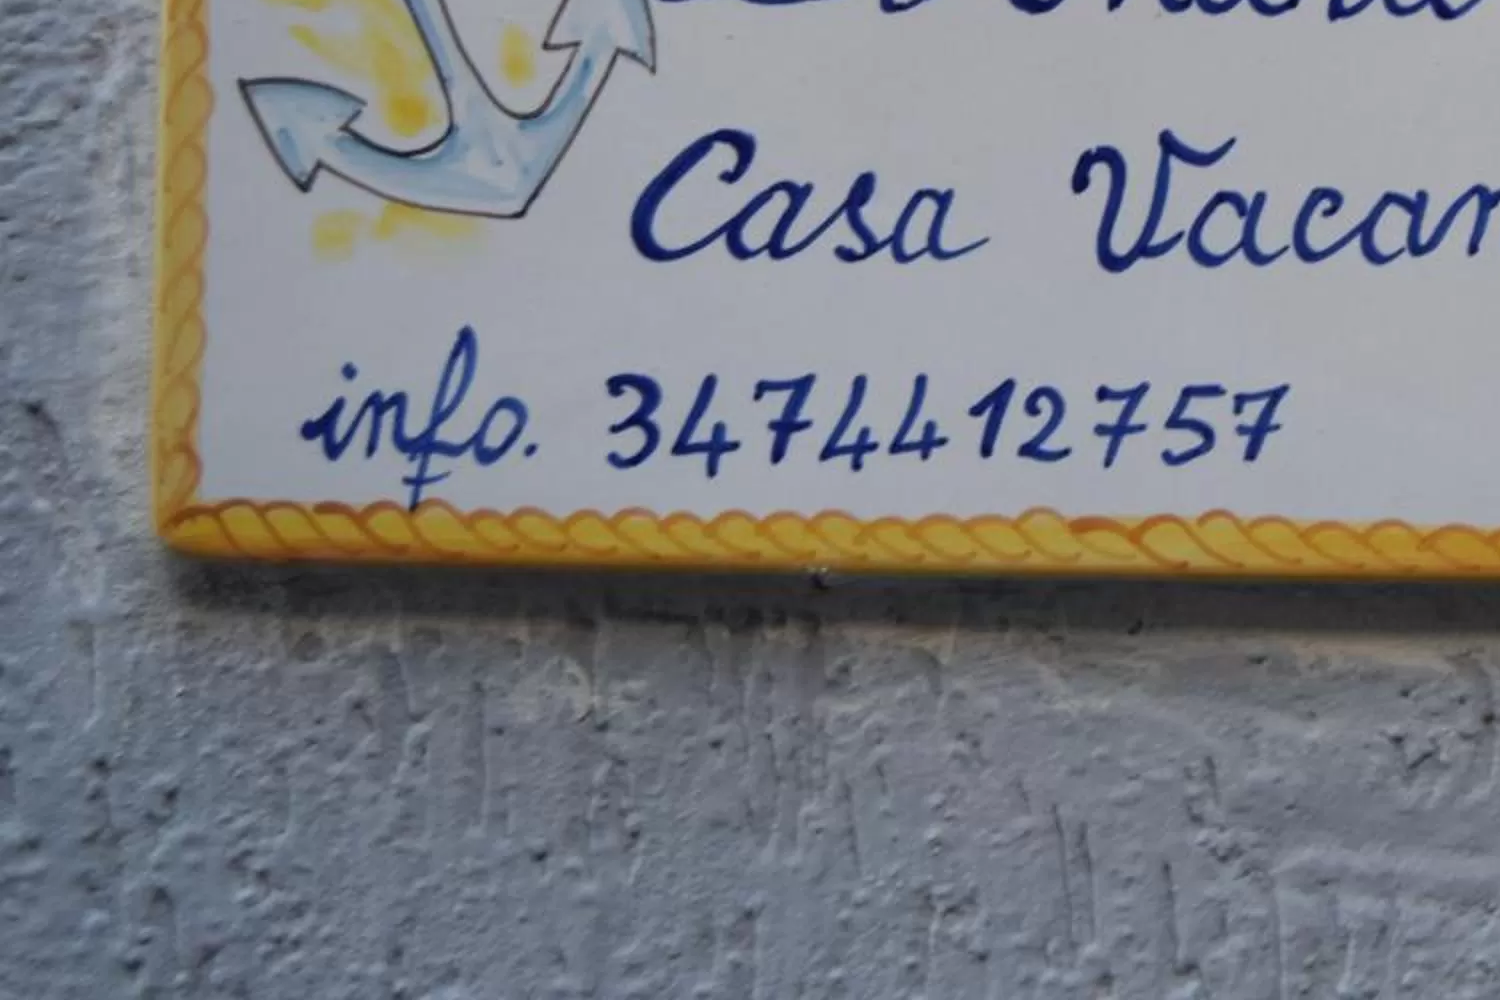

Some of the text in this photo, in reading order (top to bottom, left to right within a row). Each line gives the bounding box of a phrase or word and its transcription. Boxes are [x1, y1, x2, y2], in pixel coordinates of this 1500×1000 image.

[630, 127, 990, 265] Casa
[300, 324, 1293, 508] info. 3474412757
